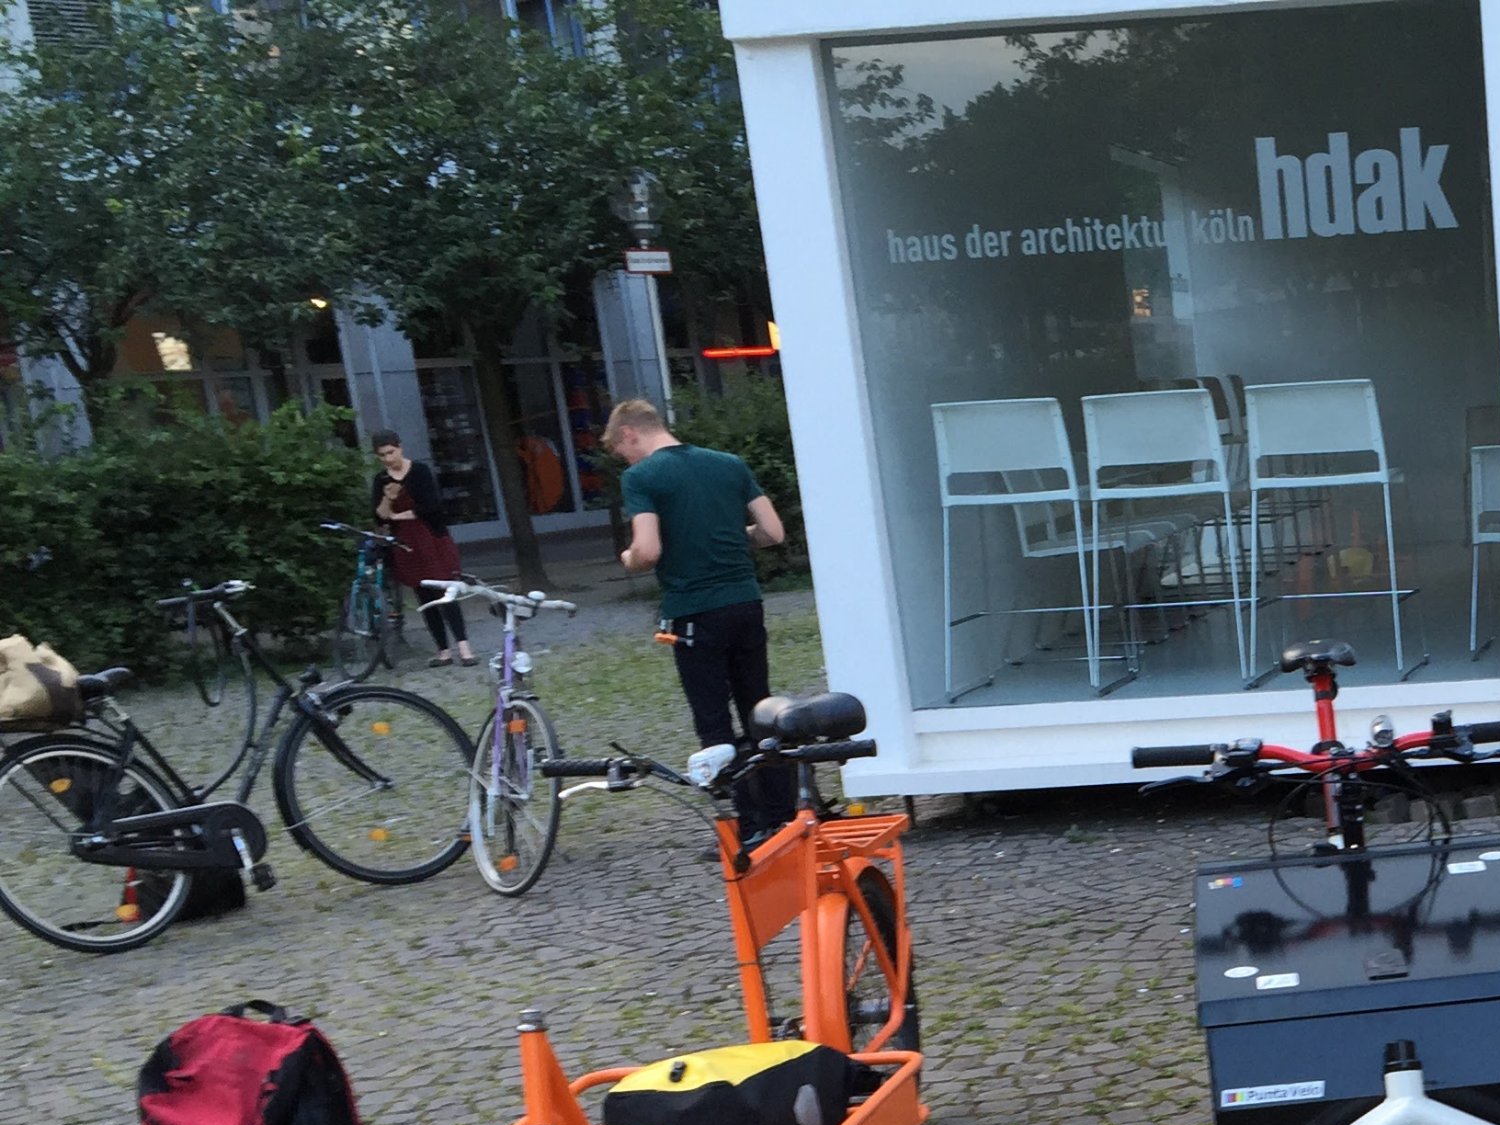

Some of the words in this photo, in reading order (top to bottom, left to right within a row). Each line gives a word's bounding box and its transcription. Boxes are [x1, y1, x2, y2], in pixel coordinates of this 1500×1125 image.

[886, 228, 959, 264] haus
[965, 223, 1013, 259] der
[1020, 214, 1180, 256] architektu
[1191, 207, 1256, 244] köln
[1254, 126, 1460, 241] hdak
